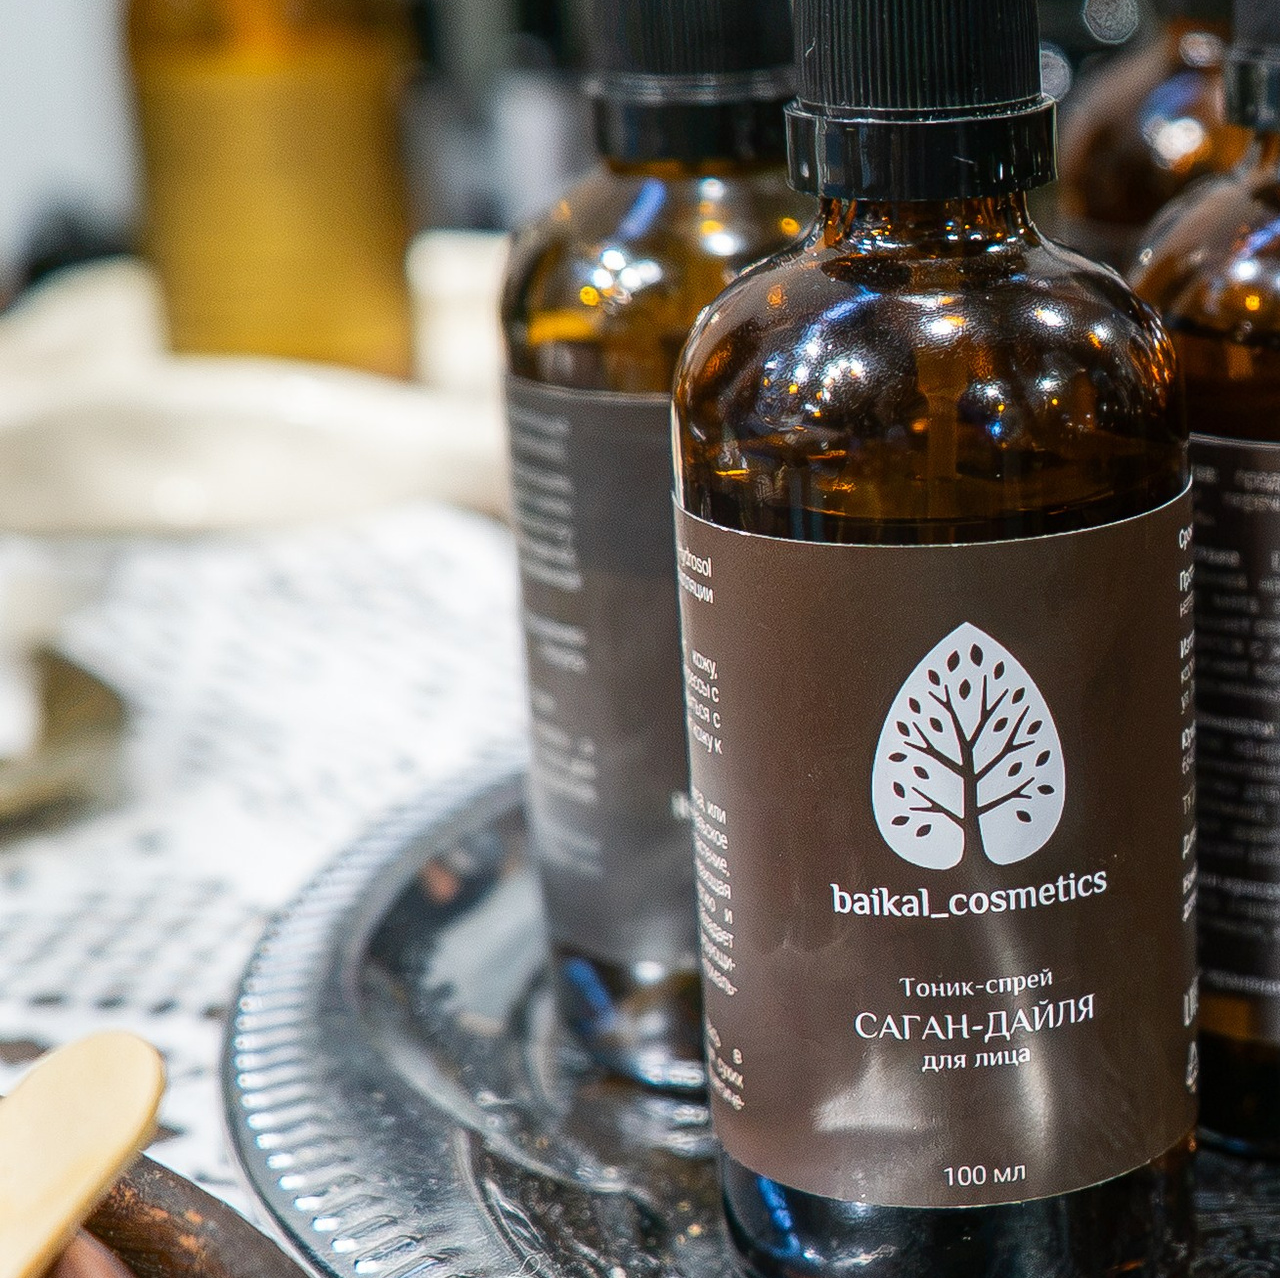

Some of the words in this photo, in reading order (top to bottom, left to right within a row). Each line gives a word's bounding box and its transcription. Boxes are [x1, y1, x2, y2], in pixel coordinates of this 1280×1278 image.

[830, 870, 1107, 918] baikal_cosmetics
[899, 969, 1053, 997] Тоник-спрей
[855, 993, 1095, 1043] САГАН-ДАЙЛЯ
[922, 1054, 967, 1073] для
[975, 1047, 1031, 1070] лица
[944, 1165, 986, 1186] 100
[994, 1164, 1026, 1183] мл
